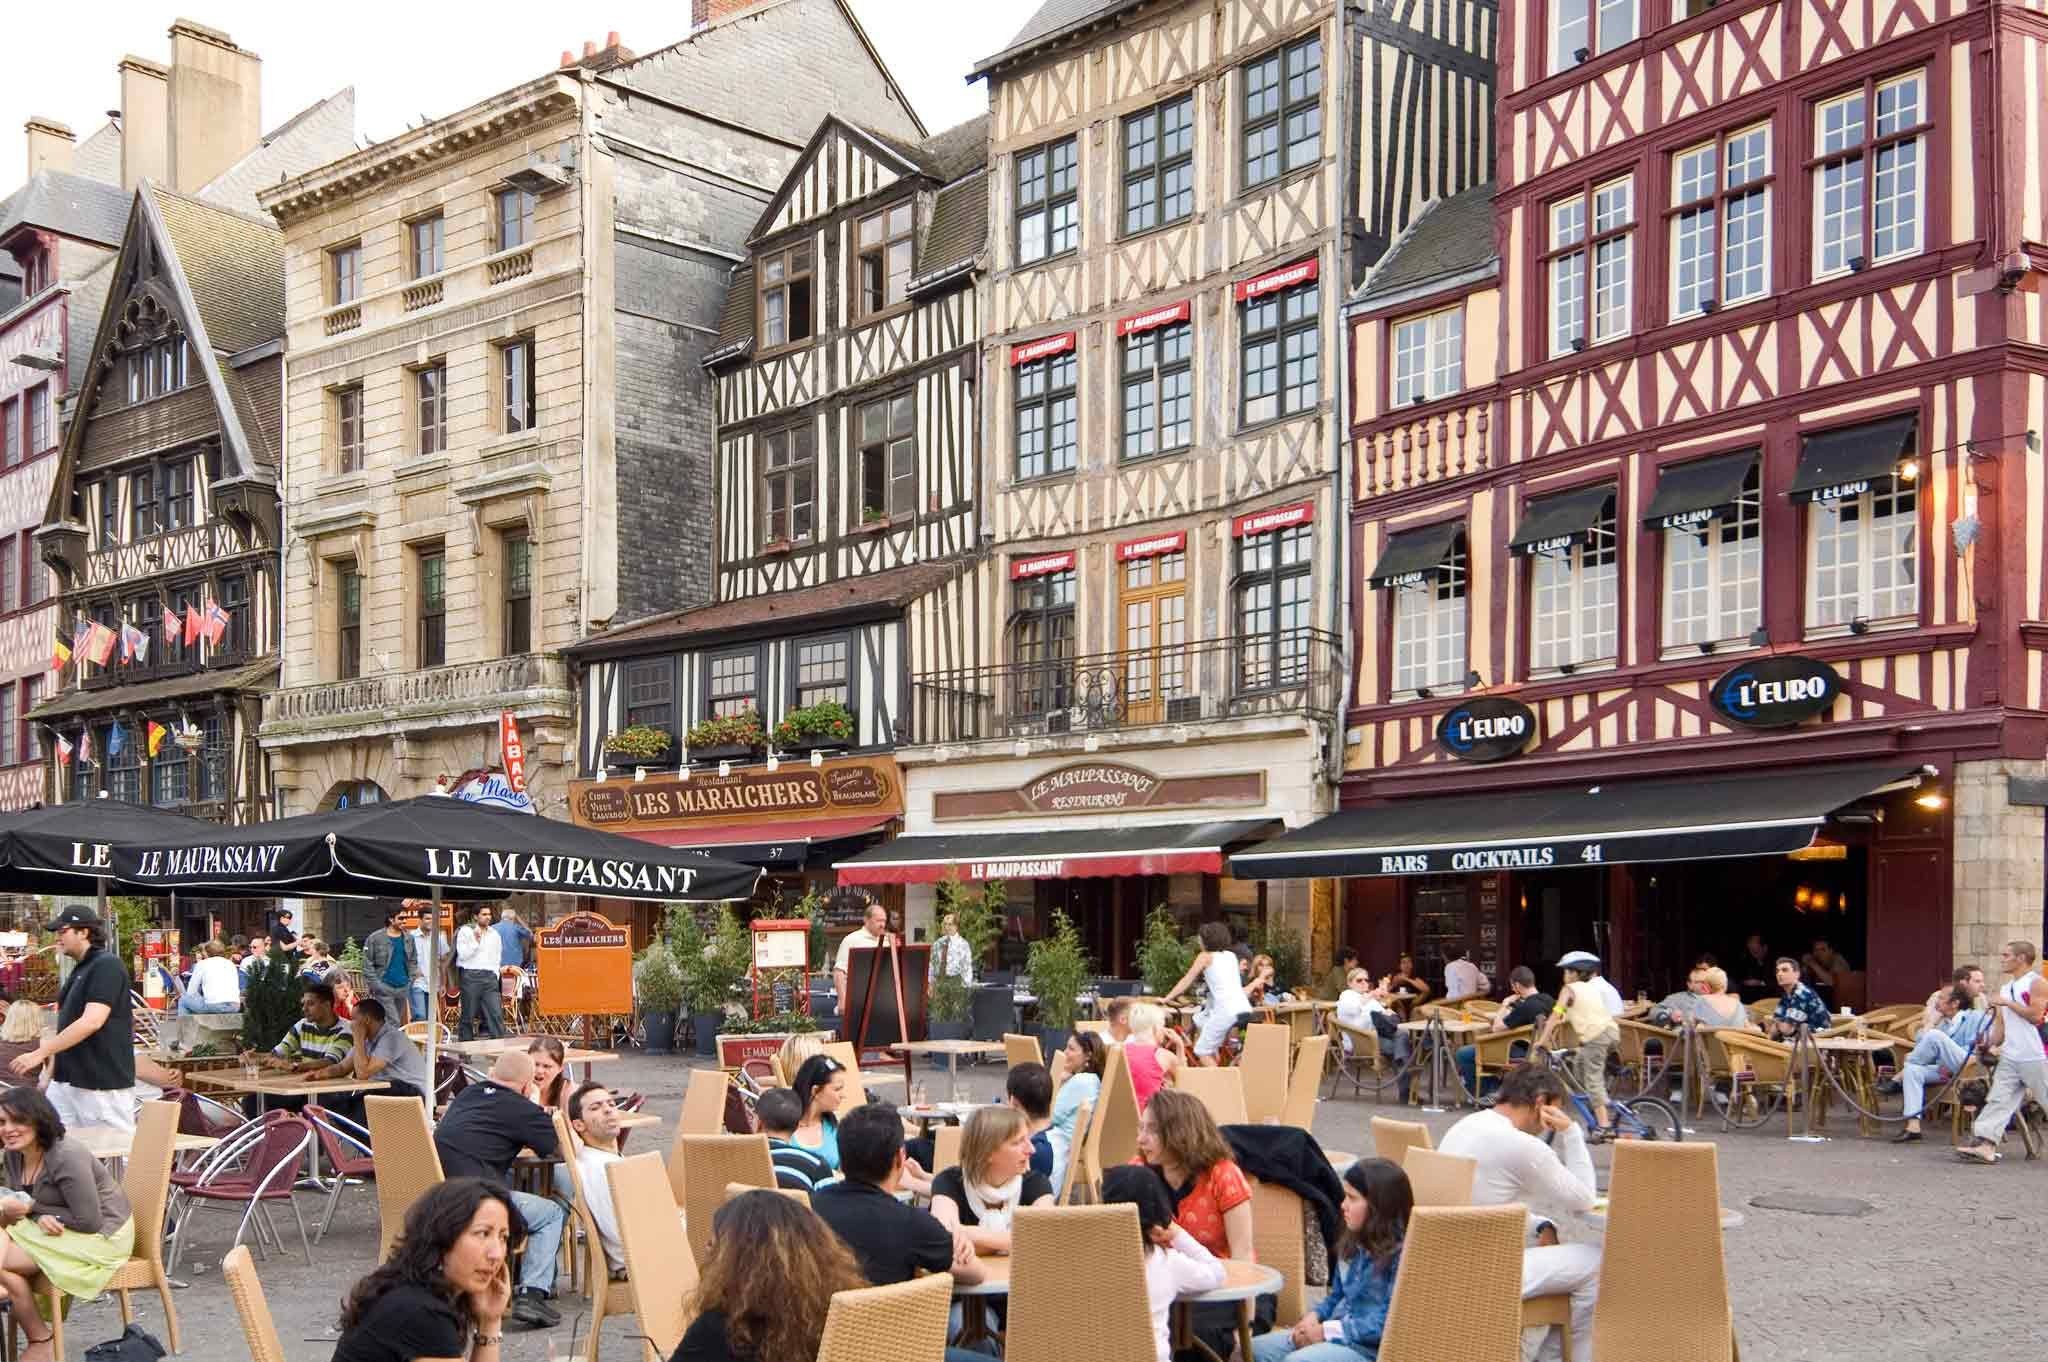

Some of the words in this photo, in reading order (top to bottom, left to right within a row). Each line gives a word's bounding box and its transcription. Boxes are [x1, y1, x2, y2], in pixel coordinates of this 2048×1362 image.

[1740, 676, 1826, 707] L'EURO
[1460, 715, 1525, 740] L'EURO
[504, 713, 527, 791] TABAC
[633, 791, 671, 816] LES
[675, 779, 818, 813] MARAICHERS
[1031, 780, 1049, 801] LE
[1050, 768, 1153, 793] MAUPASSANT
[1051, 792, 1128, 809] RESTAURANT
[72, 842, 112, 868] LE
[136, 851, 162, 877] LE
[164, 845, 285, 876] MAUPASSANT
[768, 847, 783, 859] 37
[1381, 854, 1428, 873] BARS
[1451, 847, 1554, 870] COCKTAILS
[1581, 844, 1602, 863] 41
[425, 848, 472, 878] LE
[487, 851, 698, 894] MAUPASSANT
[971, 863, 984, 879] LE
[985, 860, 1063, 879] MAUPASSANT
[543, 936, 561, 945] LES
[564, 934, 624, 945] MARAICHERS
[742, 1047, 752, 1057] LE
